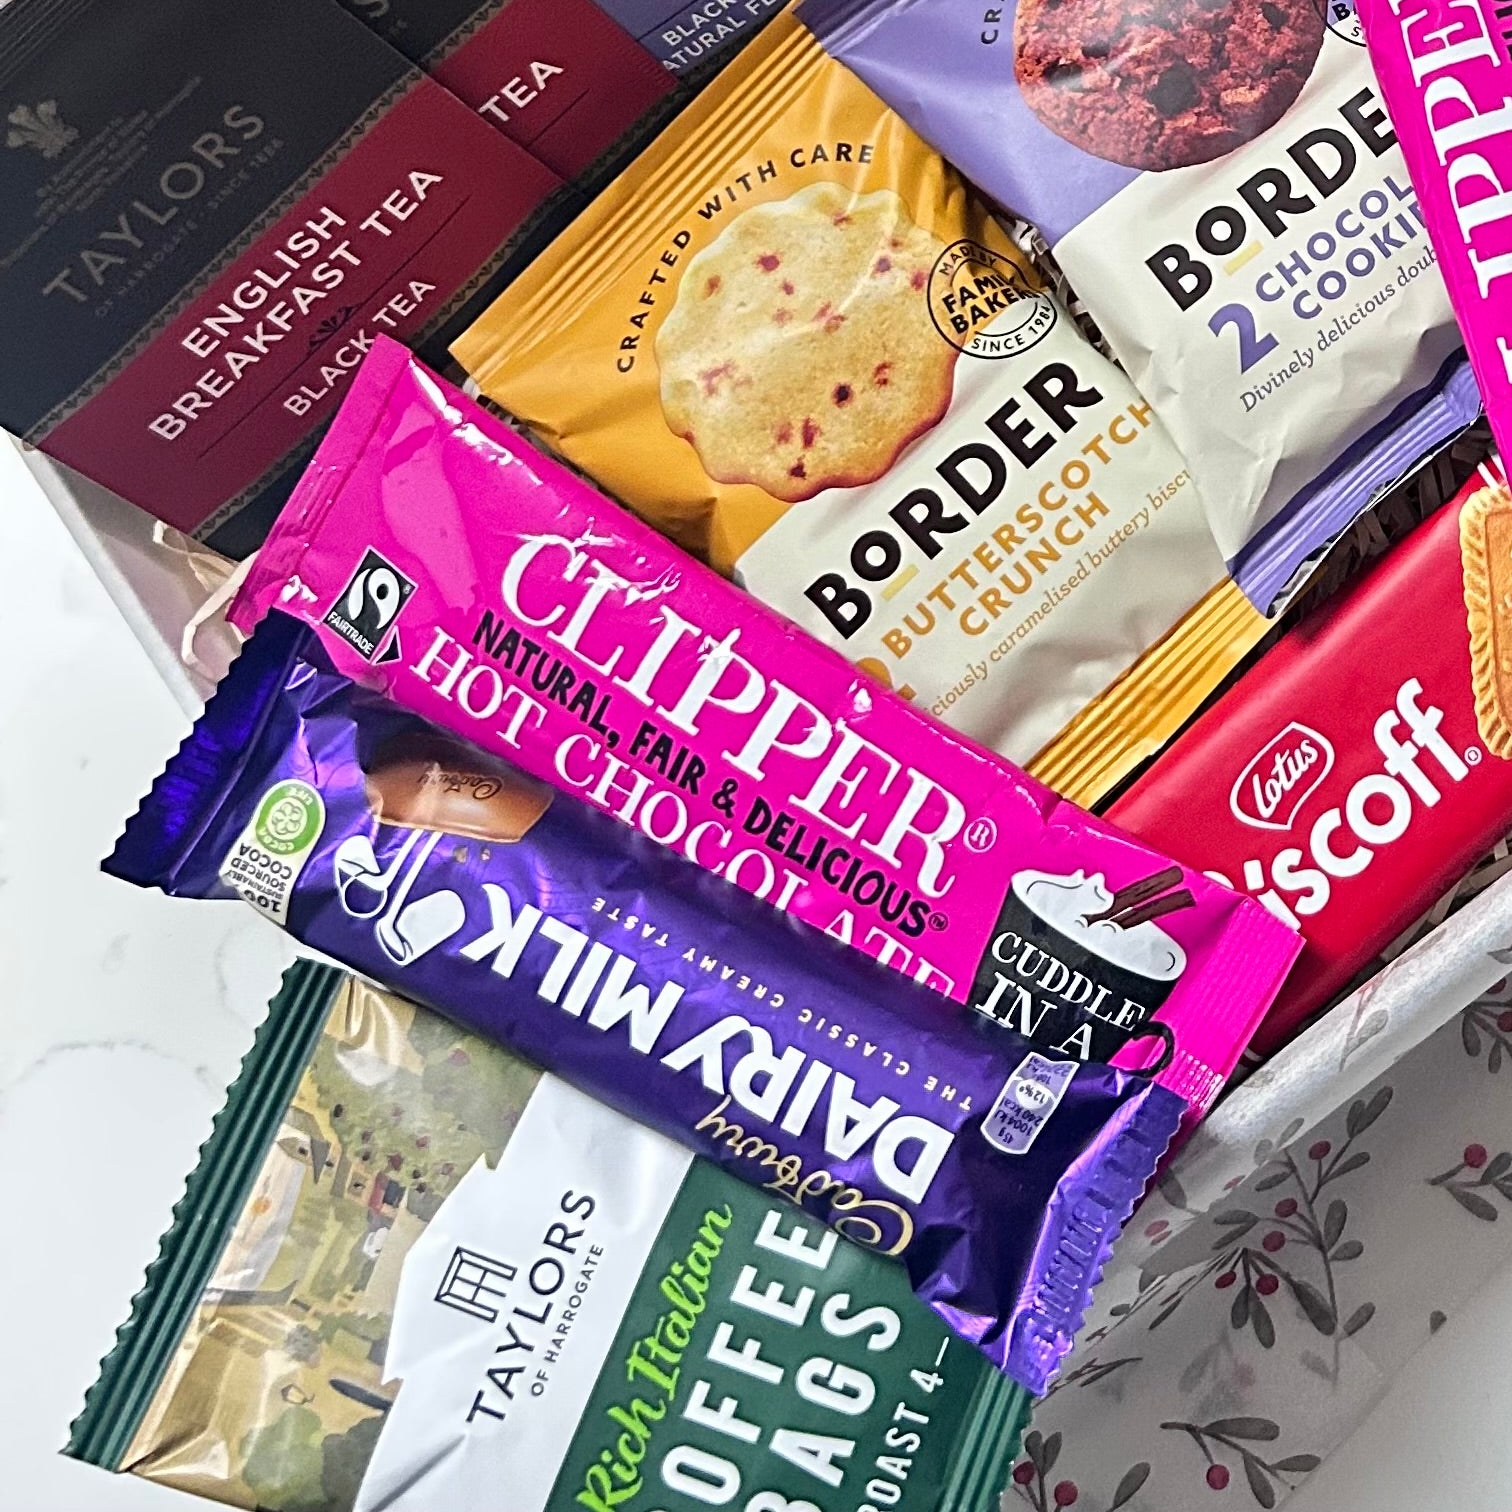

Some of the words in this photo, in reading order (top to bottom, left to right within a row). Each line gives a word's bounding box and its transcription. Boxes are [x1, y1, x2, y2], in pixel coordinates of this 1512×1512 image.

[477, 60, 566, 123] TEA
[663, 15, 747, 73] ATURAL
[41, 104, 265, 304] TAYLORS
[616, 228, 693, 374] CRAFTED
[697, 160, 778, 221] WITH
[789, 142, 875, 169] CARE
[1144, 86, 1400, 312] BORDE
[1207, 301, 1280, 375] 2
[1254, 175, 1415, 302] CHOCOL
[1292, 199, 1429, 320] COOKI
[148, 239, 362, 441] BREAKFAST
[359, 170, 444, 238] TEA
[181, 206, 347, 359] ENGLISH
[283, 328, 376, 417] BLACK
[371, 280, 437, 328] TEA
[971, 333, 1026, 352] SINCE
[1239, 344, 1316, 413] Divinely
[1316, 283, 1397, 352] delicious
[1396, 244, 1439, 288] doub
[803, 362, 1104, 640] BORDER
[881, 399, 1153, 661] BUTTERSCOTCH
[959, 491, 1112, 638] CRUNCH
[326, 610, 374, 656] FAIRTRADE
[924, 660, 989, 718] ciously
[990, 562, 1092, 663] caramelised
[1090, 508, 1150, 569] buttery
[1147, 470, 1192, 509] bisc
[409, 626, 548, 751] HOT
[500, 535, 969, 899] CLIPPER
[472, 610, 620, 747] NATURAL,
[628, 720, 708, 797] FAIR
[711, 777, 739, 818] &
[743, 795, 934, 939] DELICIOUS
[1203, 677, 1469, 931] iscoff
[231, 857, 287, 893] SOURCED
[239, 844, 292, 880] COCOA
[590, 896, 670, 948] TASTE
[460, 883, 686, 1055] MILK
[681, 946, 785, 1008] CREAMY
[797, 1007, 910, 1076] CLASSIC
[974, 971, 1058, 1038] IN
[1049, 1022, 1093, 1061] A
[991, 931, 1146, 1031] CUDDLE
[660, 1014, 956, 1205] DAIRY
[924, 1074, 972, 1111] THE
[696, 1094, 914, 1256] Cadbury
[465, 1189, 596, 1424] TAYLORS
[531, 1369, 549, 1397] OF
[544, 1243, 604, 1363] HARROGATE
[576, 1396, 667, 1512] Rich
[625, 1203, 733, 1402] Italian
[642, 1209, 840, 1512] OFFEE
